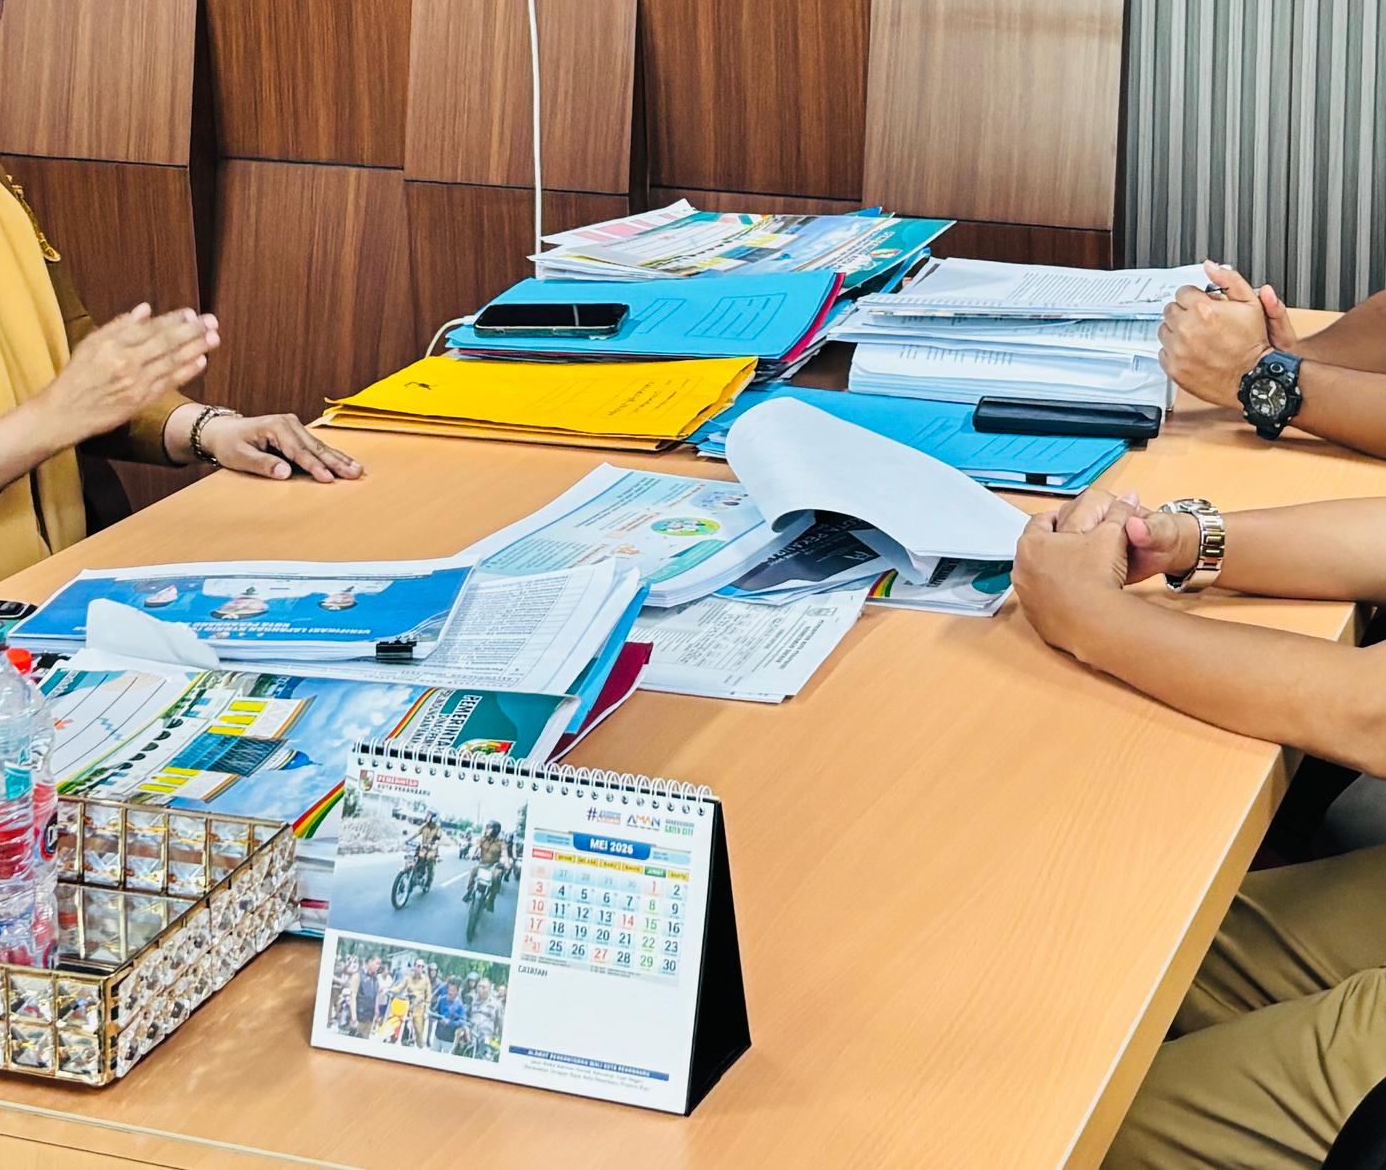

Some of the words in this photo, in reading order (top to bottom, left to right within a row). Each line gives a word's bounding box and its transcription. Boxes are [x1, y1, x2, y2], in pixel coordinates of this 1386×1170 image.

[590, 838, 608, 850] MEI
[610, 841, 634, 855] 2026
[536, 882, 543, 892] 3
[558, 885, 565, 896] 4
[581, 888, 588, 900] 5
[603, 892, 610, 903] 6
[626, 896, 633, 907] 7
[649, 900, 655, 910] 8
[672, 903, 679, 914] 9
[674, 884, 681, 896] 2
[532, 900, 544, 911] 10
[555, 903, 565, 915] 11
[577, 907, 589, 919] 12
[600, 910, 612, 922] 13
[622, 914, 634, 926] 14
[645, 918, 657, 930] 15
[668, 921, 680, 934] 16
[530, 918, 542, 929] 17
[553, 921, 564, 933] 18
[575, 925, 587, 937] 19
[597, 929, 610, 941] 20
[619, 933, 631, 945] 21
[642, 937, 655, 949] 22
[665, 940, 678, 953] 23
[549, 940, 563, 952] 25
[572, 944, 585, 956] 26
[594, 948, 607, 959] 27
[617, 951, 631, 964] 28
[640, 955, 653, 967] 29
[663, 959, 676, 971] 30
